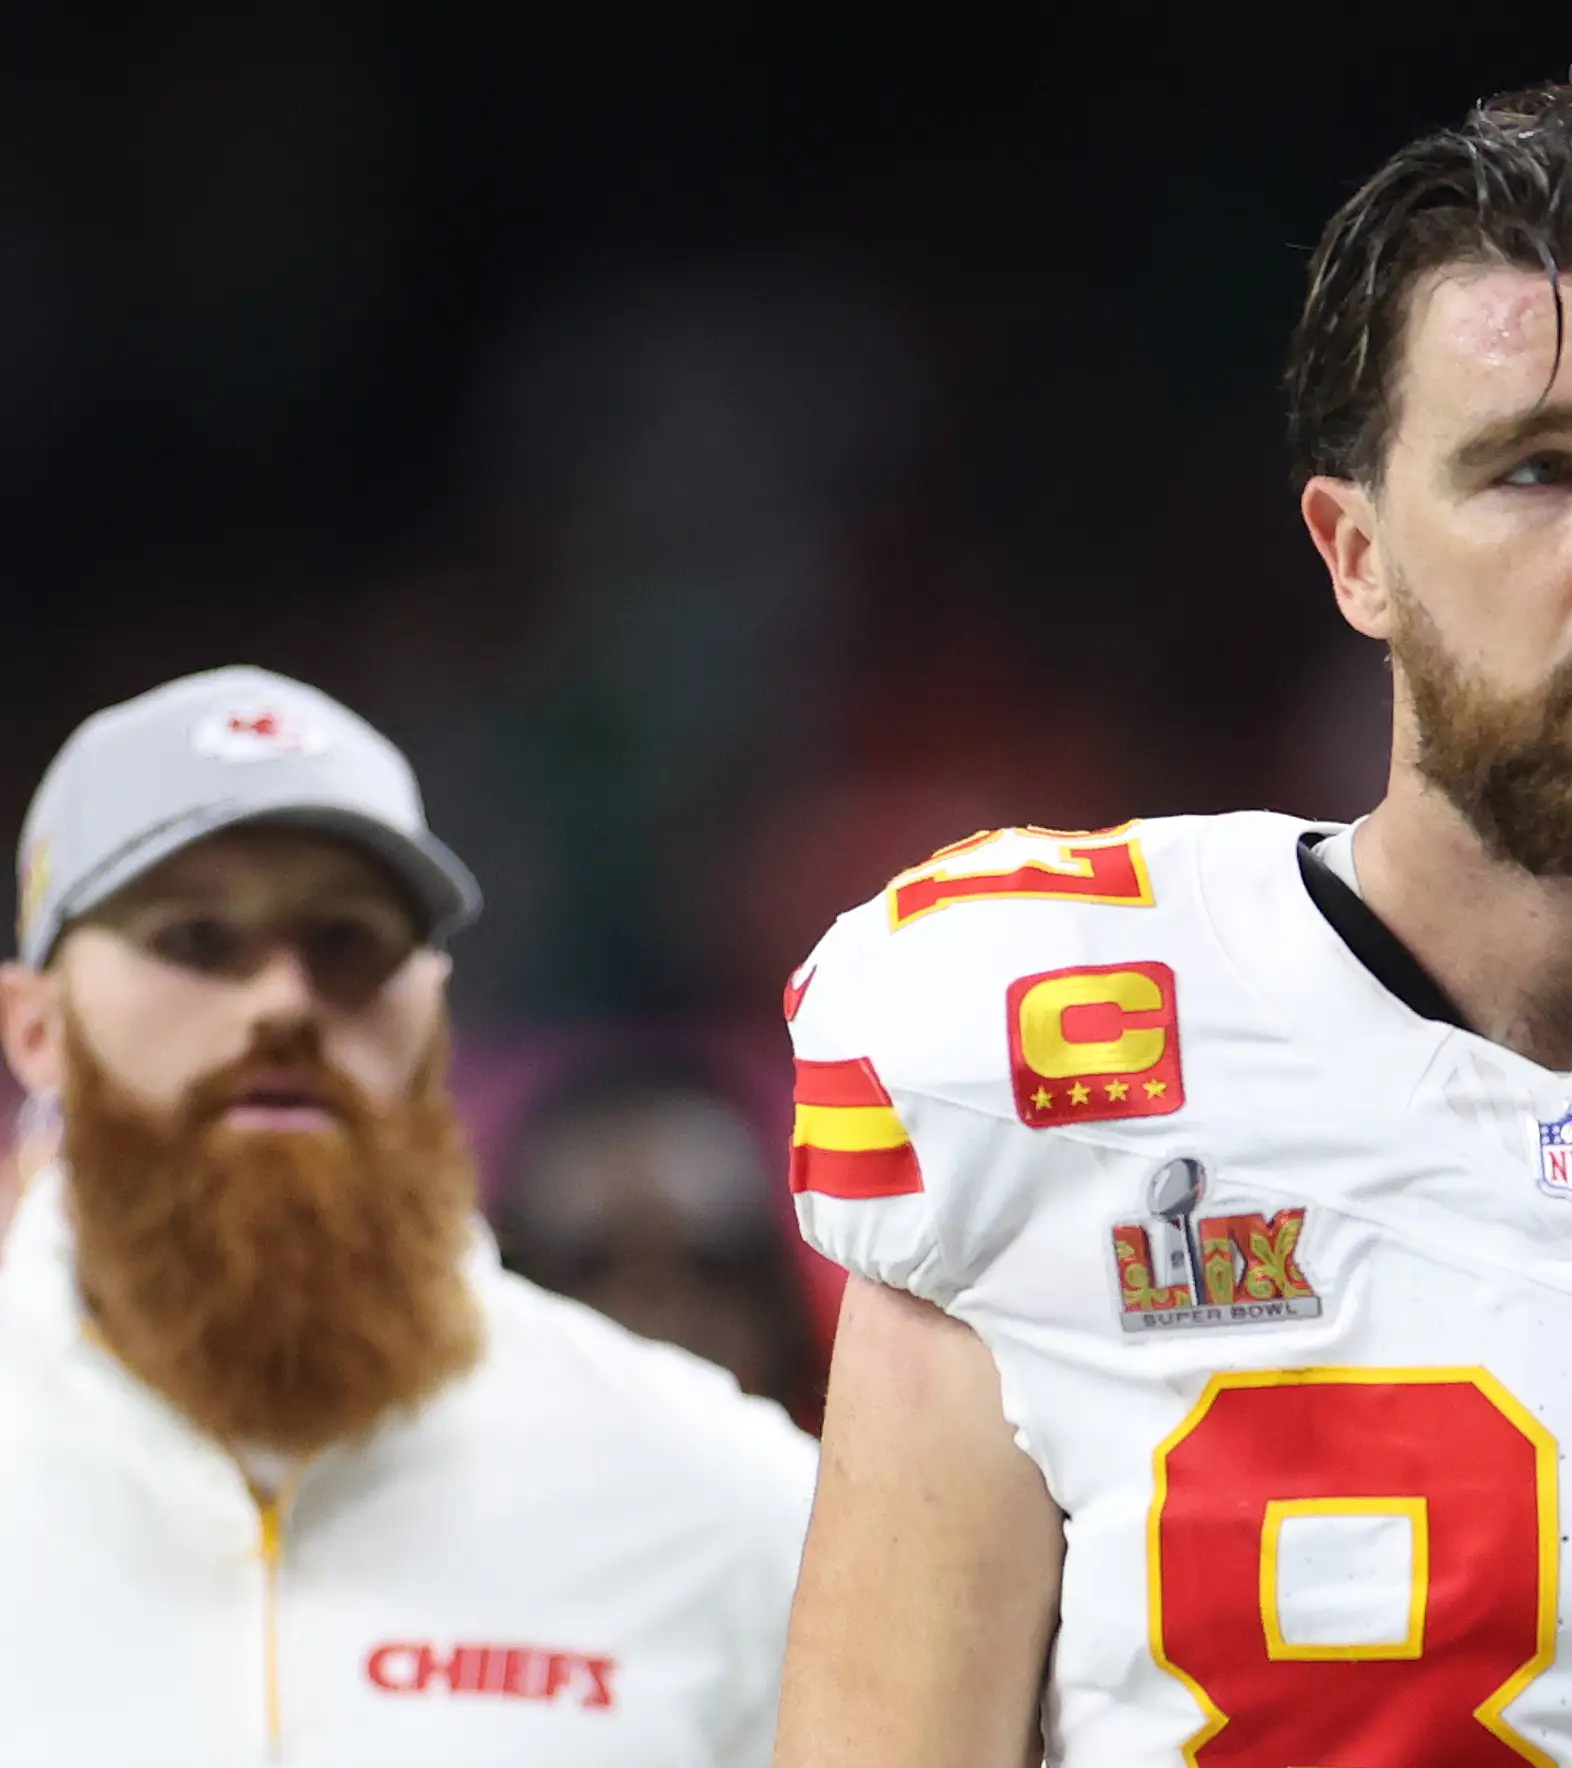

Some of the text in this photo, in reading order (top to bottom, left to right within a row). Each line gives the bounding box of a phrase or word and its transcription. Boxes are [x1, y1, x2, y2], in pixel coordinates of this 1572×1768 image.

[1019, 971, 1166, 1079] C
[1143, 1302, 1298, 1327] SUPER BOWL
[366, 1640, 616, 1710] CHIEFS
